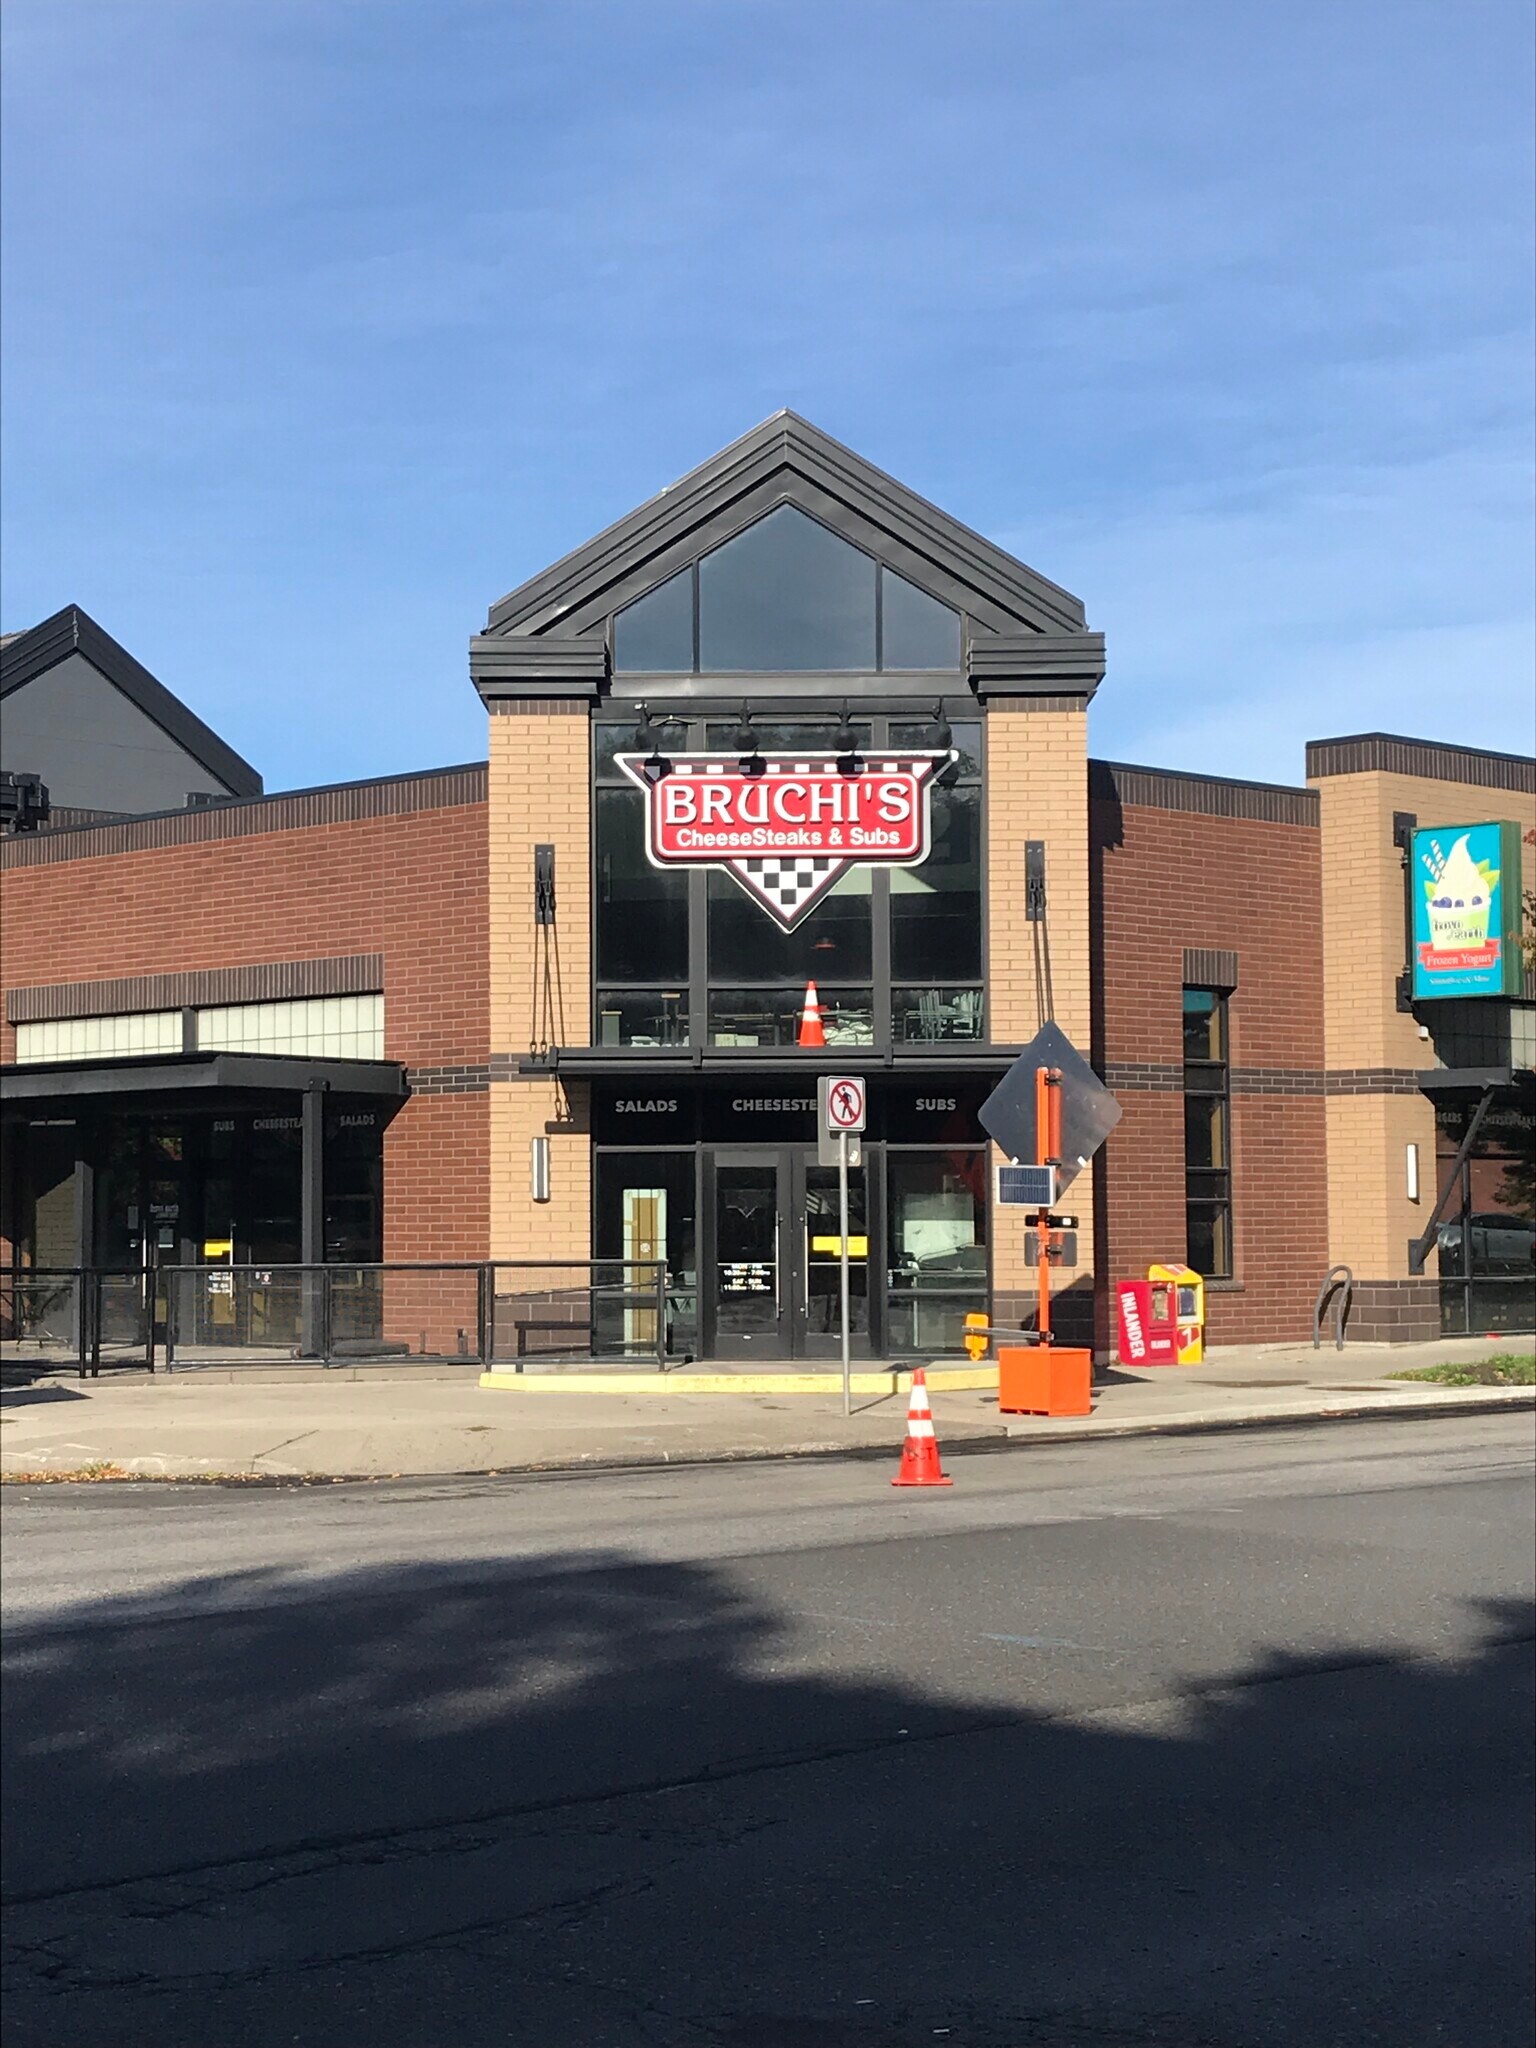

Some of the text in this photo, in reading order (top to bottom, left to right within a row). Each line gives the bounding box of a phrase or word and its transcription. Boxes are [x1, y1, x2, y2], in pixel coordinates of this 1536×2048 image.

[664, 782, 911, 825] BRUCHI'S
[676, 826, 901, 847] CheeseSteaks & Subs
[1427, 953, 1492, 967] Frozen Yogurt
[615, 1099, 678, 1113] SALADS
[732, 1098, 818, 1112] CHEESESTE
[915, 1098, 957, 1111] SUBS
[1120, 1291, 1146, 1359] INLANDER
